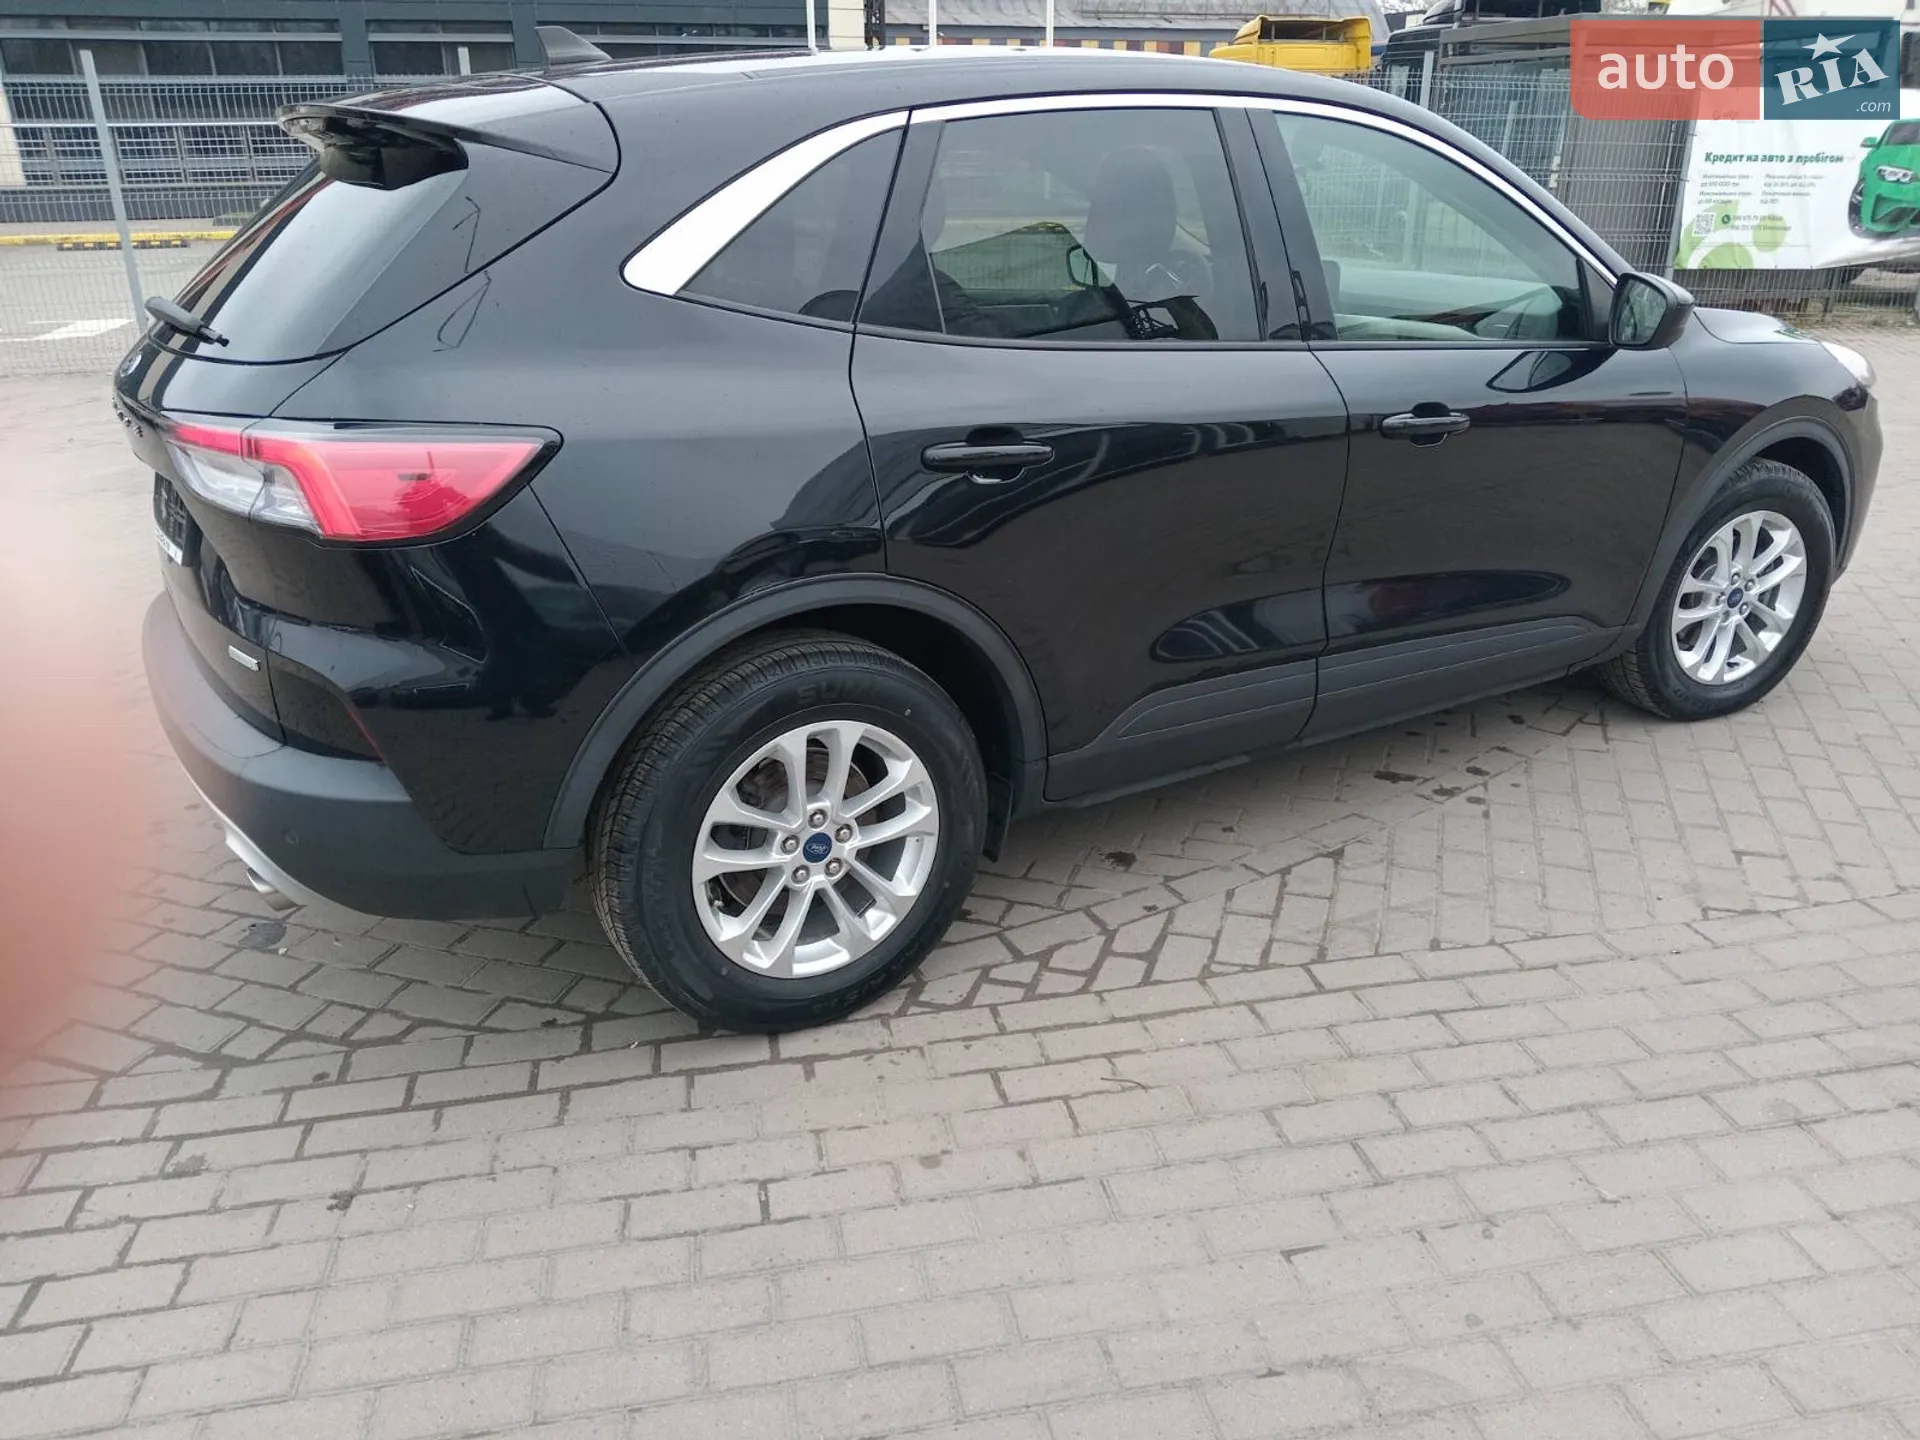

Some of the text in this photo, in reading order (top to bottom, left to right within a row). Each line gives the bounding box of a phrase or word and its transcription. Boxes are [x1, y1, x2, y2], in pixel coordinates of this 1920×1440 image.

[1704, 151, 1845, 165] Кредит на авто з пробігом
